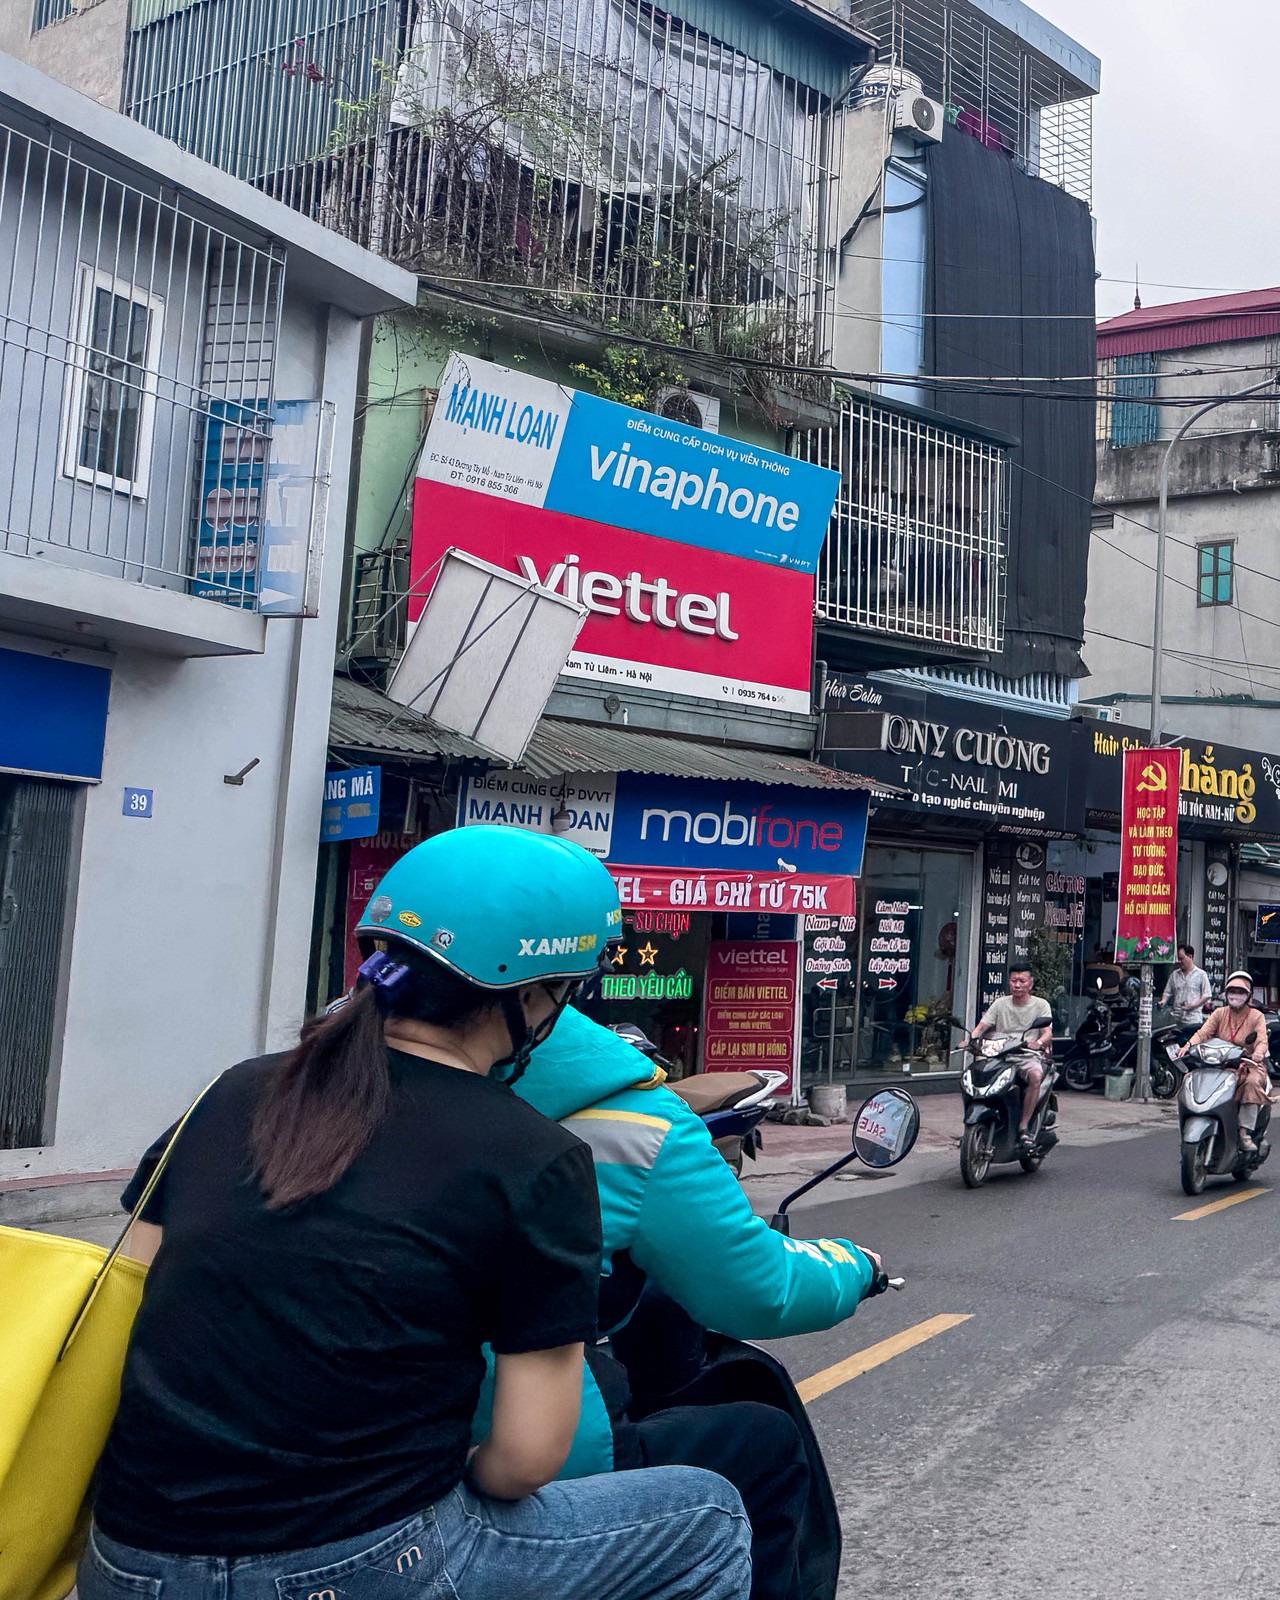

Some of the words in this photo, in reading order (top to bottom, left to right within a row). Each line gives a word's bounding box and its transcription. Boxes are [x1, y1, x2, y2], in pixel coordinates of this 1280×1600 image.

[445, 383, 507, 435] MẠNH
[505, 401, 559, 450] LOAN
[653, 427, 680, 443] CUNG
[702, 443, 725, 456] DỊCH
[726, 449, 739, 462] VỤ
[760, 458, 790, 476] THÔNG
[465, 474, 486, 486] 0916
[589, 441, 800, 532] vinaphone
[517, 554, 739, 641] viettel
[626, 668, 637, 679] Hà
[639, 671, 652, 683] Nội
[823, 678, 848, 698] Hair
[849, 684, 883, 706] Salon
[887, 714, 950, 759] ONY
[954, 724, 1051, 775] CƯỜNG
[324, 778, 346, 801] NG
[351, 771, 373, 797] MÃ
[511, 782, 547, 796] CUNG
[578, 789, 611, 803] DVVT
[1179, 745, 1256, 824] hắng
[131, 793, 147, 811] 39
[921, 792, 941, 808] tạo
[973, 800, 1010, 816] chuyên
[1011, 805, 1045, 822] nghiệp
[1136, 807, 1151, 821] HỌC
[1152, 805, 1166, 821] TẬP
[640, 801, 843, 851] mobifone
[1128, 825, 1137, 838] VÀ
[1139, 824, 1154, 838] LÀM
[1156, 826, 1173, 838] THEO
[1132, 845, 1142, 857] TƯ
[1133, 864, 1147, 878] ĐẠO
[670, 874, 707, 905] GIÁ
[715, 874, 753, 907] CHỈ
[759, 879, 786, 908] TỪ
[790, 885, 828, 910] 75K
[1126, 883, 1150, 896] PHONG
[1151, 882, 1171, 896] CÁCH
[1136, 901, 1148, 915] CHÍ
[718, 949, 788, 965] viettel
[602, 976, 637, 997] THEO
[639, 970, 664, 997] YÊU
[666, 969, 693, 998] CẦU
[757, 986, 788, 999] VIETTEL
